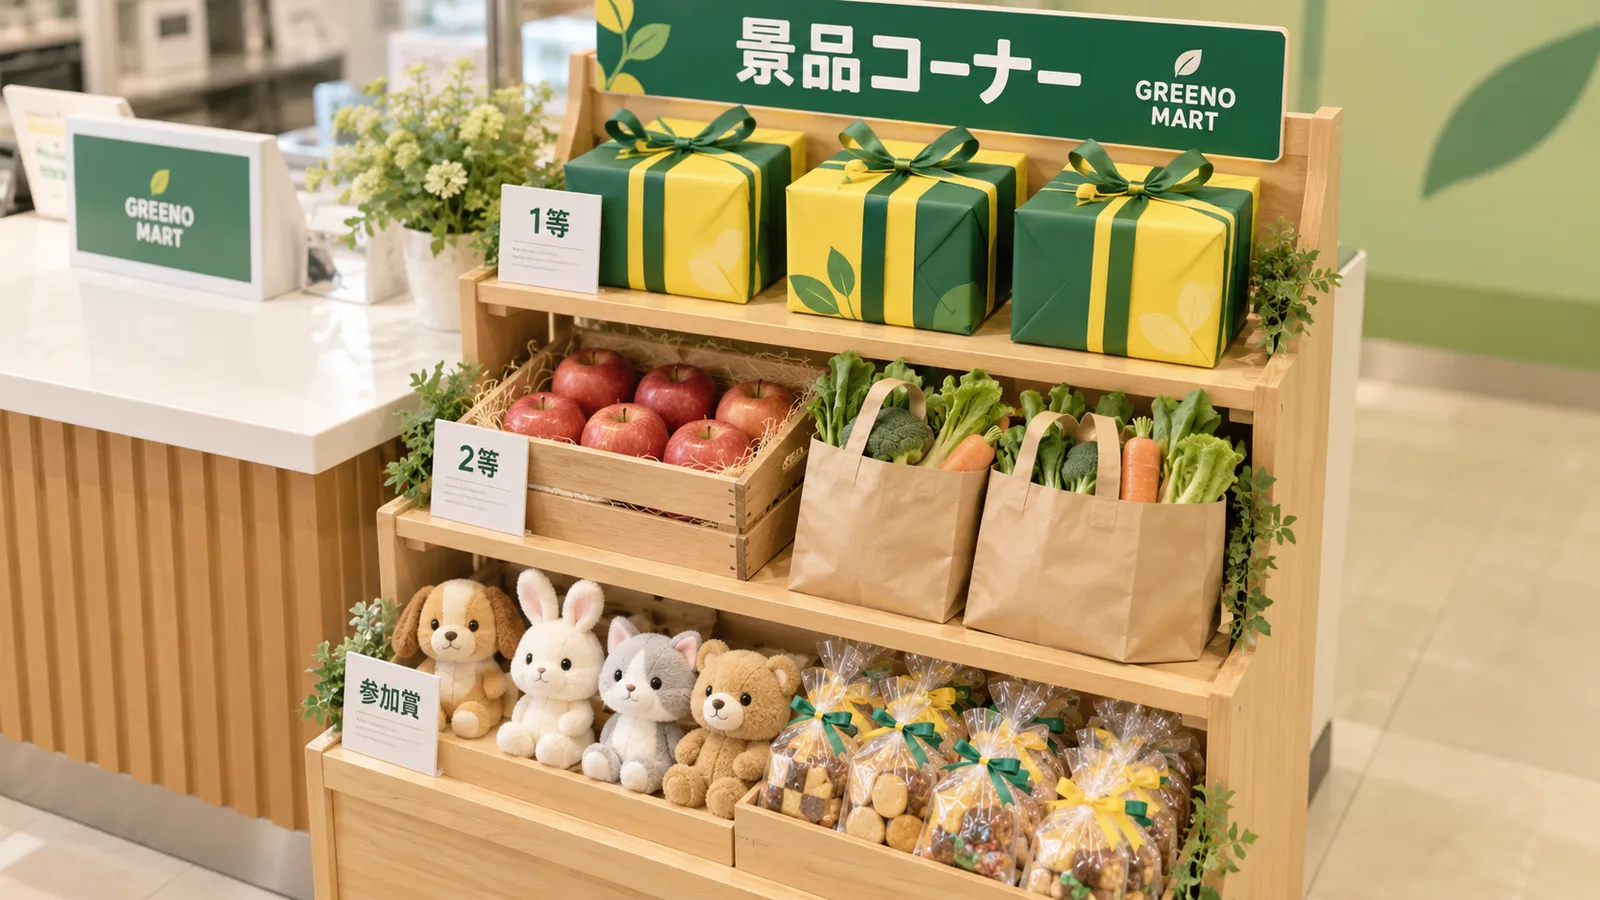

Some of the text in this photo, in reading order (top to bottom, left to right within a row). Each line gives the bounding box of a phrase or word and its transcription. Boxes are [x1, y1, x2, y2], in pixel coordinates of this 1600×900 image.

[735, 16, 1082, 105] 景品コーナー
[1135, 79, 1236, 109] GREENO
[1151, 105, 1219, 131] MART
[124, 196, 195, 227] GREENO
[529, 207, 570, 239] 1等
[136, 221, 184, 248] MART
[458, 444, 500, 479] 2等
[359, 678, 421, 720] 参加賞
